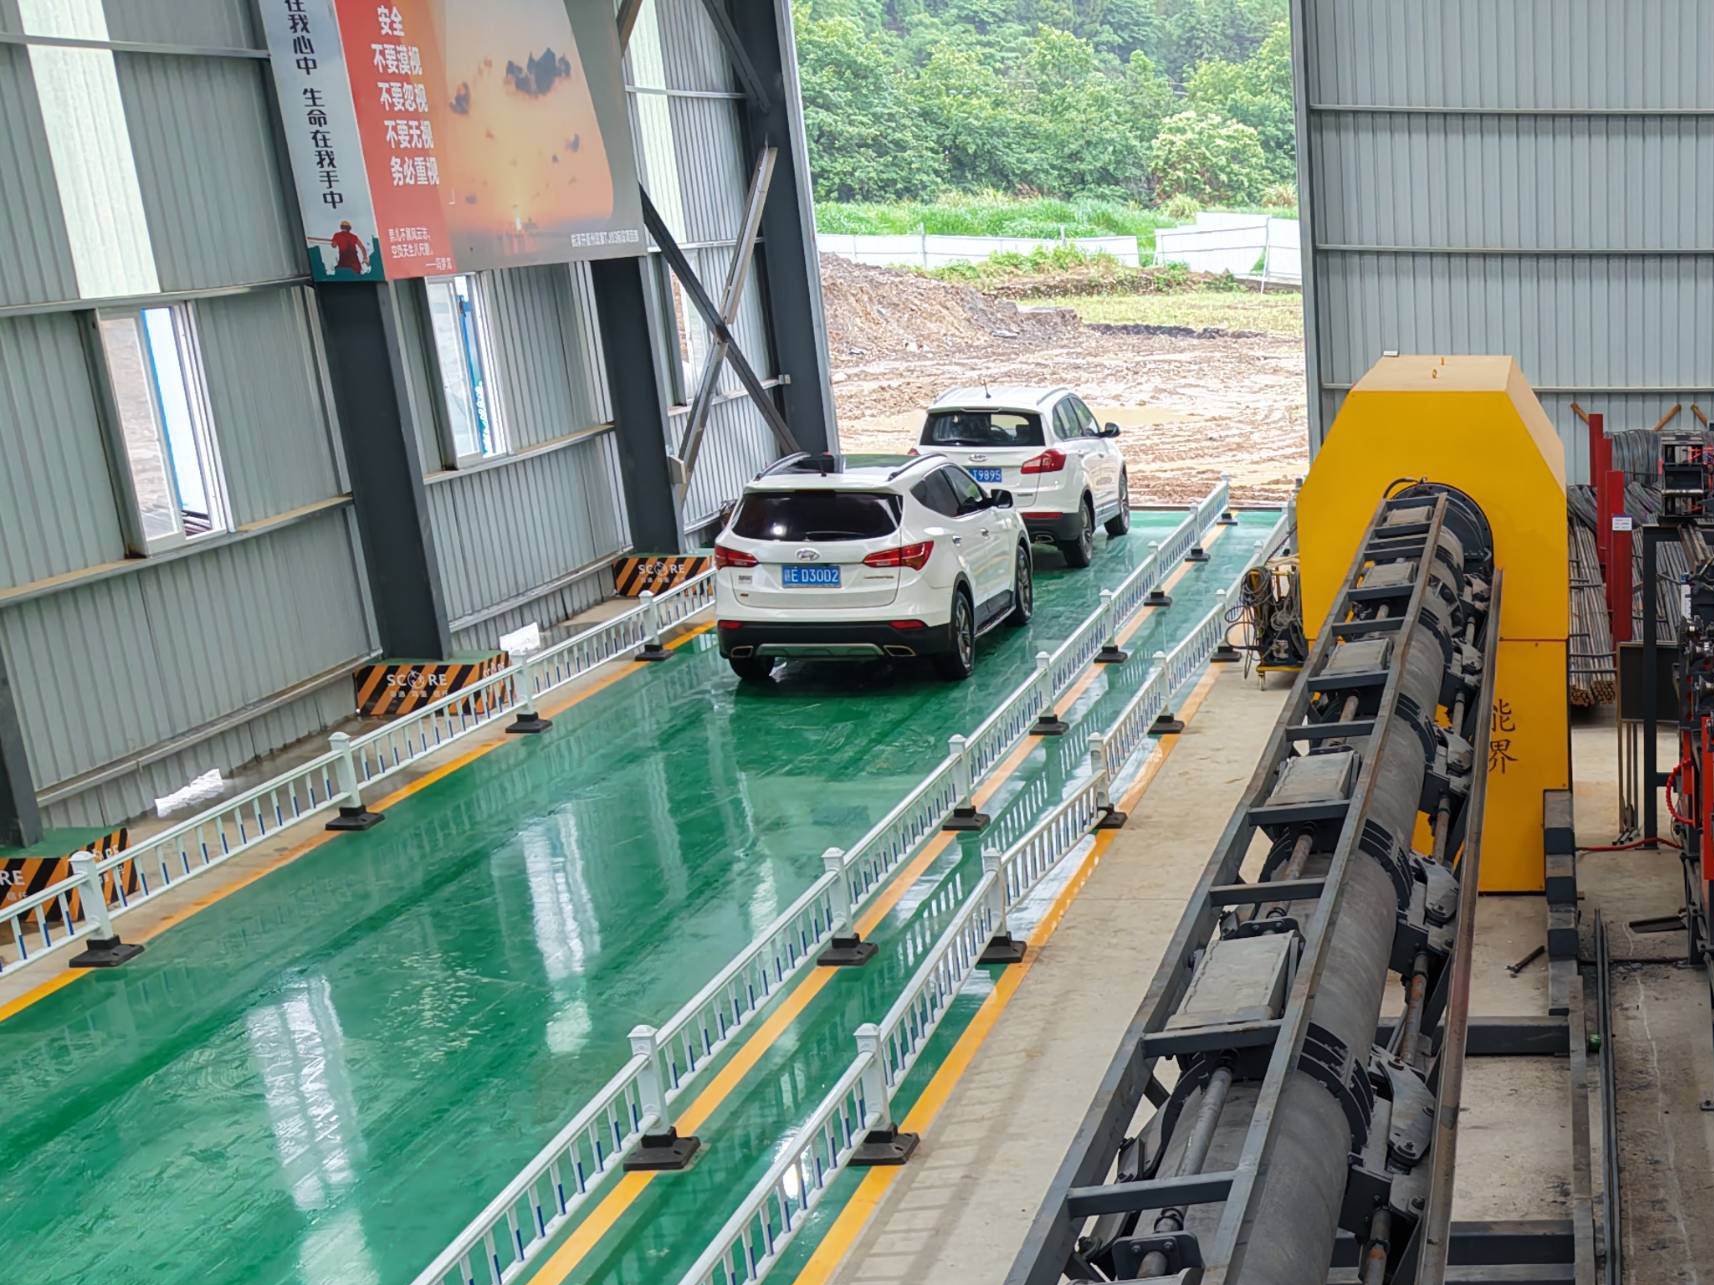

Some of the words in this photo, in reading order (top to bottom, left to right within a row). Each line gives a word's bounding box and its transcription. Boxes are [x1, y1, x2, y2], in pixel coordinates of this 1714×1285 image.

[377, 5, 404, 36] 安全
[371, 43, 422, 75] 不要漠视
[377, 82, 428, 111] 不要忽视
[384, 120, 433, 148] 不要无视
[390, 156, 439, 185] 务必重视
